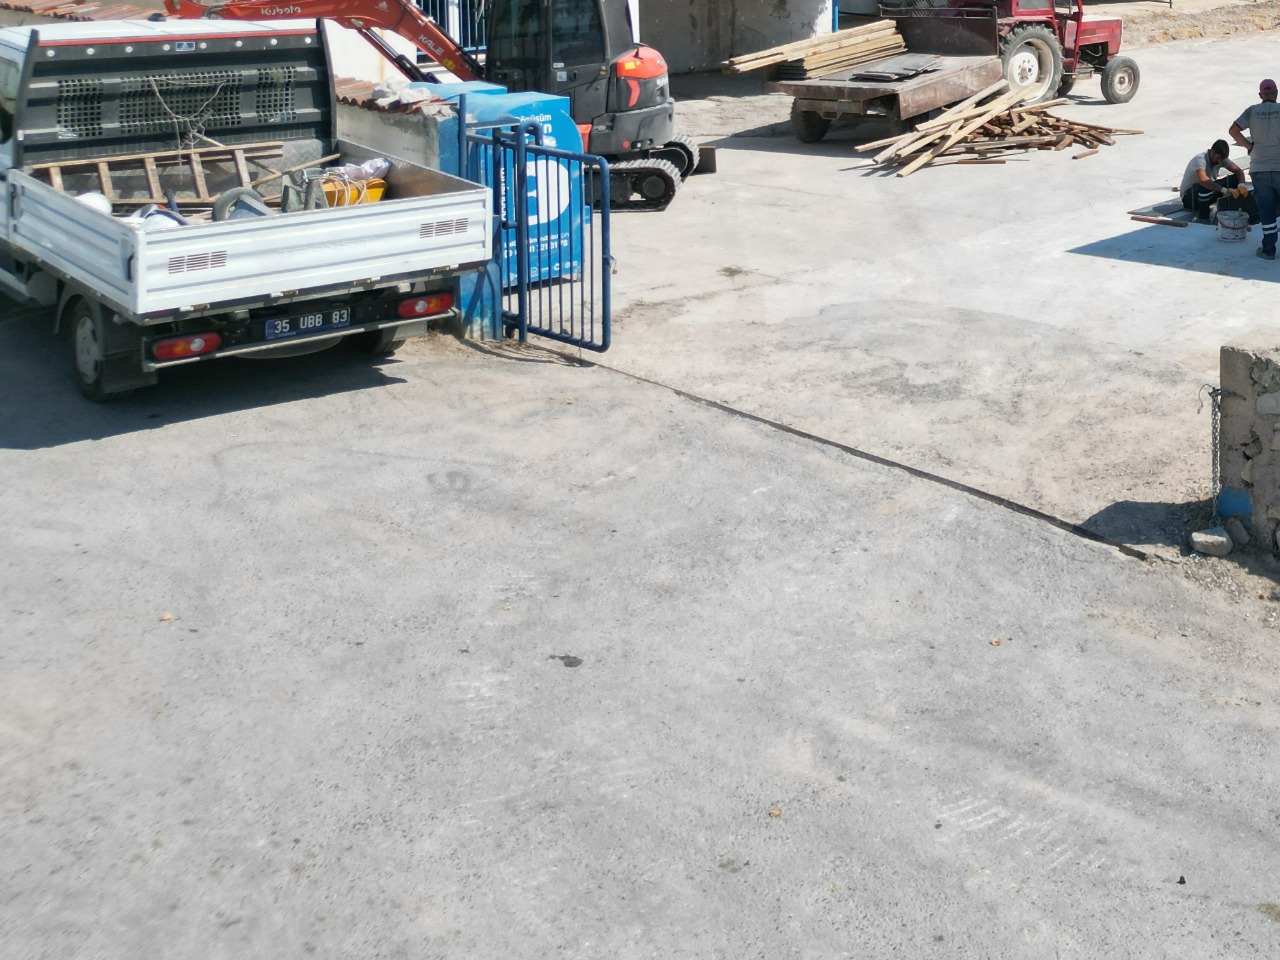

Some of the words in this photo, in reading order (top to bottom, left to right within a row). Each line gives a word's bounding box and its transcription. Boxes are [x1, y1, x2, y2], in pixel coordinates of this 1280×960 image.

[261, 6, 301, 15] Kubota
[419, 34, 445, 56] KALE
[274, 320, 290, 334] 35
[300, 314, 323, 329] UBB
[332, 309, 347, 324] 83
